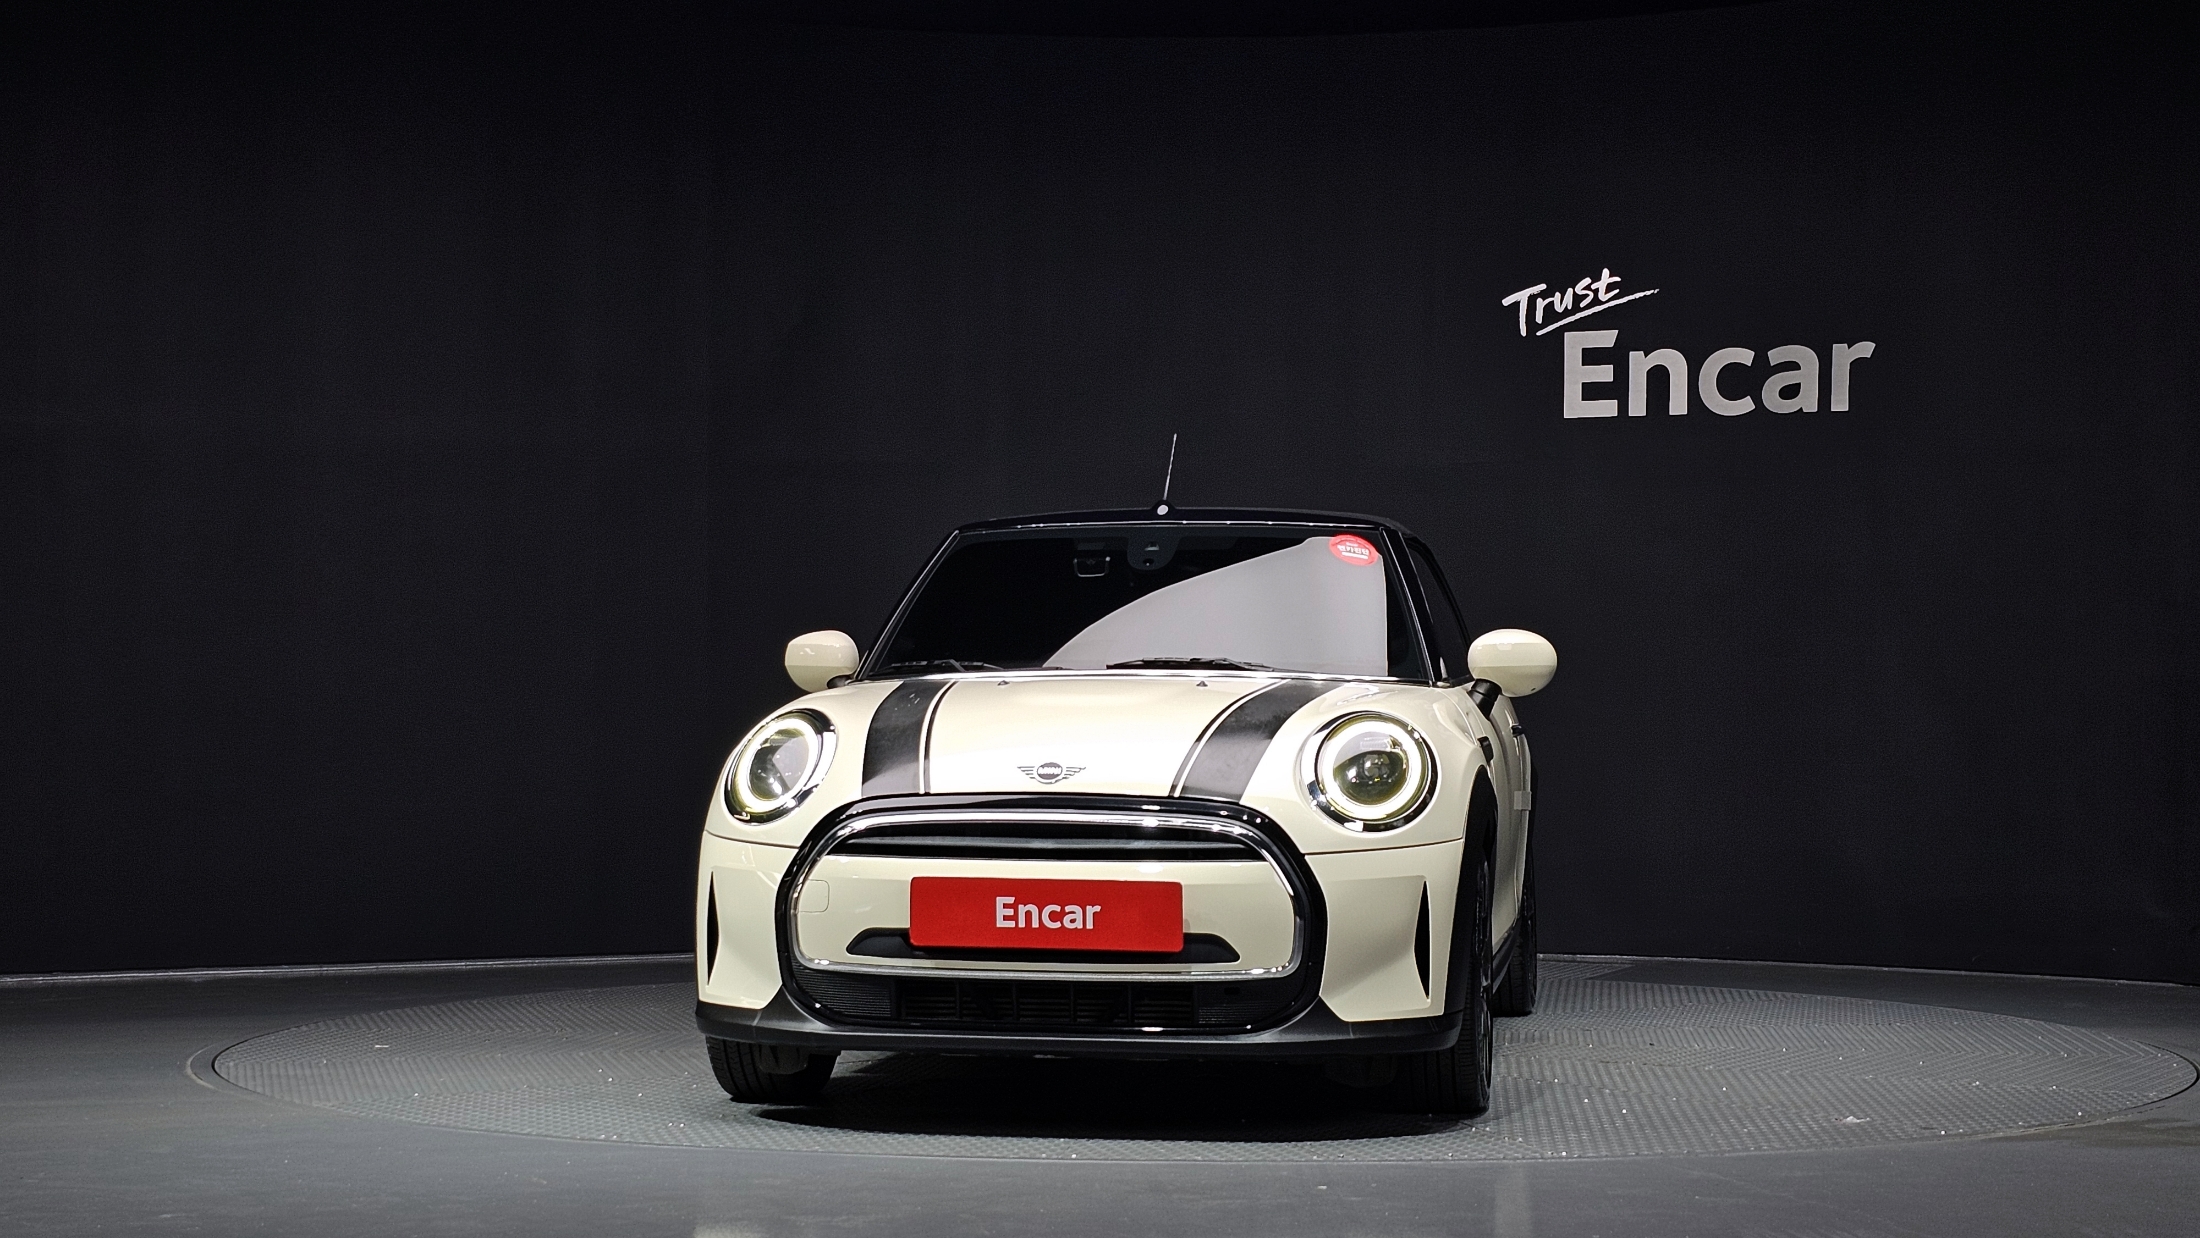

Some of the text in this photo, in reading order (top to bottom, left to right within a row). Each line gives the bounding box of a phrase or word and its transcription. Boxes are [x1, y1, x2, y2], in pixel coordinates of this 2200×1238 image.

[1502, 268, 1622, 337] Trust
[1563, 329, 1876, 419] Encar
[995, 896, 1101, 930] Encar
